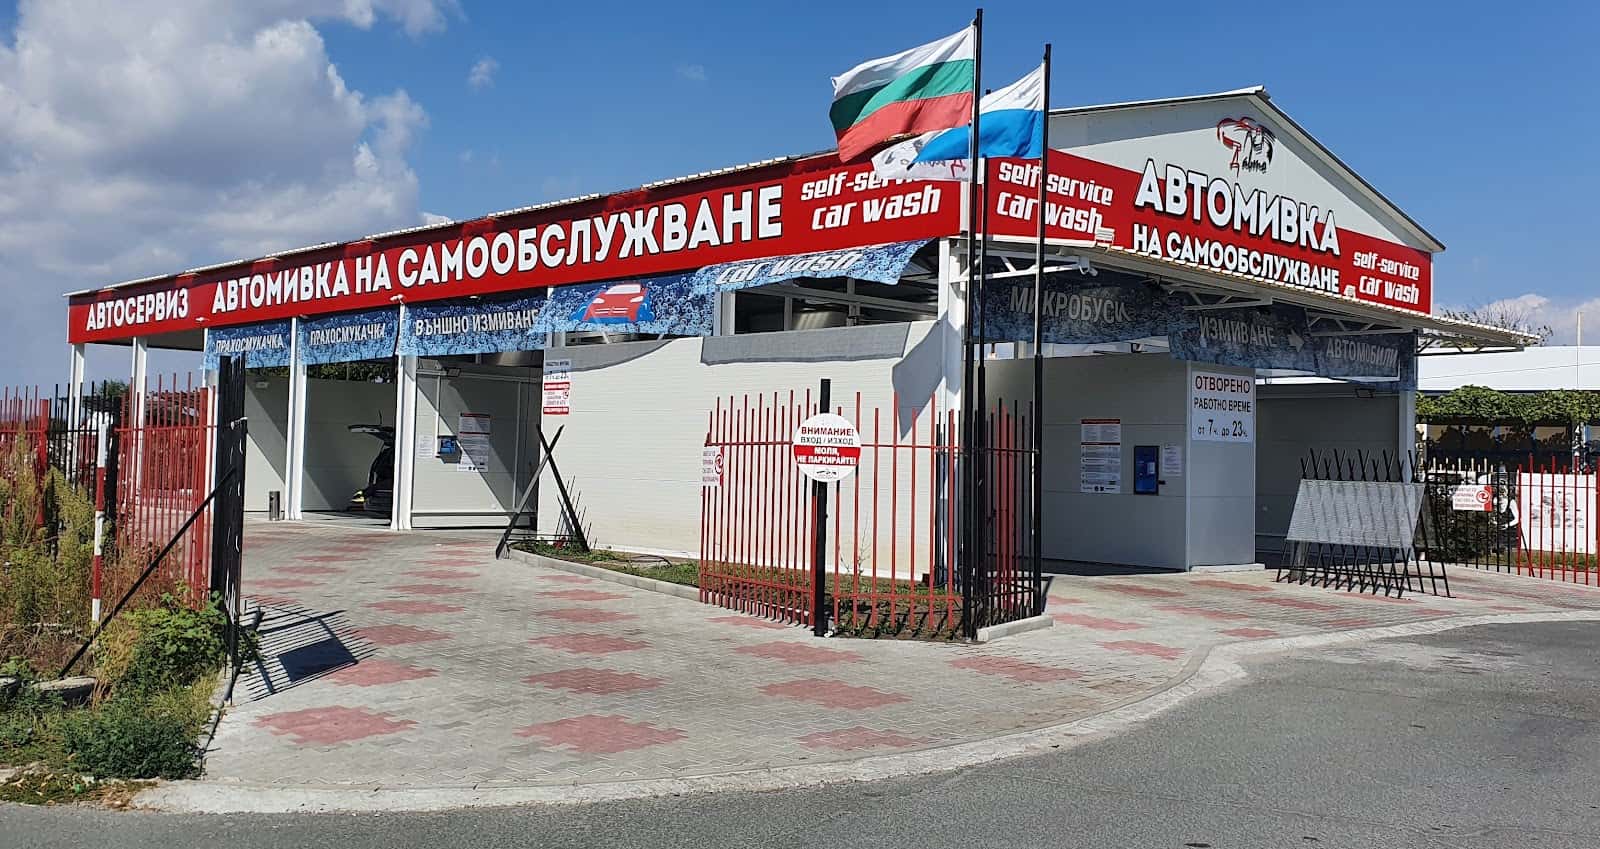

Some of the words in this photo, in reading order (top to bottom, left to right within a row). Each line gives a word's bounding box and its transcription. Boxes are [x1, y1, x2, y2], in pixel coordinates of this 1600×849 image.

[800, 171, 921, 201] self-se
[998, 161, 1114, 206] selfservice
[811, 202, 858, 231] car
[862, 184, 942, 223] wash
[996, 191, 1039, 221] car
[1044, 201, 1103, 234] wash
[1134, 157, 1341, 256] АВТОМИВКА
[86, 288, 189, 332] АВТОСЕРВИЗ
[211, 256, 350, 315] АВТОМИВКА
[354, 253, 394, 293] НА
[397, 184, 784, 290] САМООБСЛУЖВАНЕ
[715, 262, 771, 285] car
[768, 251, 864, 277] wash
[1132, 223, 1163, 258] НА
[1166, 231, 1340, 292] САМООБСЛУЖВАНЕ
[1353, 251, 1420, 281] self-service
[1359, 275, 1383, 297] car
[1384, 281, 1420, 305] wash
[415, 315, 470, 336] ВЪНШНО
[1200, 315, 1279, 348] ИЗМИВАНЕ
[215, 333, 285, 354] ПРАХОСМУКАЧКА
[1326, 337, 1398, 368] АВТОМОБИЛИ
[1195, 375, 1251, 394] ОТВОРЕНО
[1194, 397, 1227, 411] РАБОТНО
[1228, 400, 1251, 413] ВРЕМЕ
[801, 426, 854, 437] ВНИМАНИЕ!
